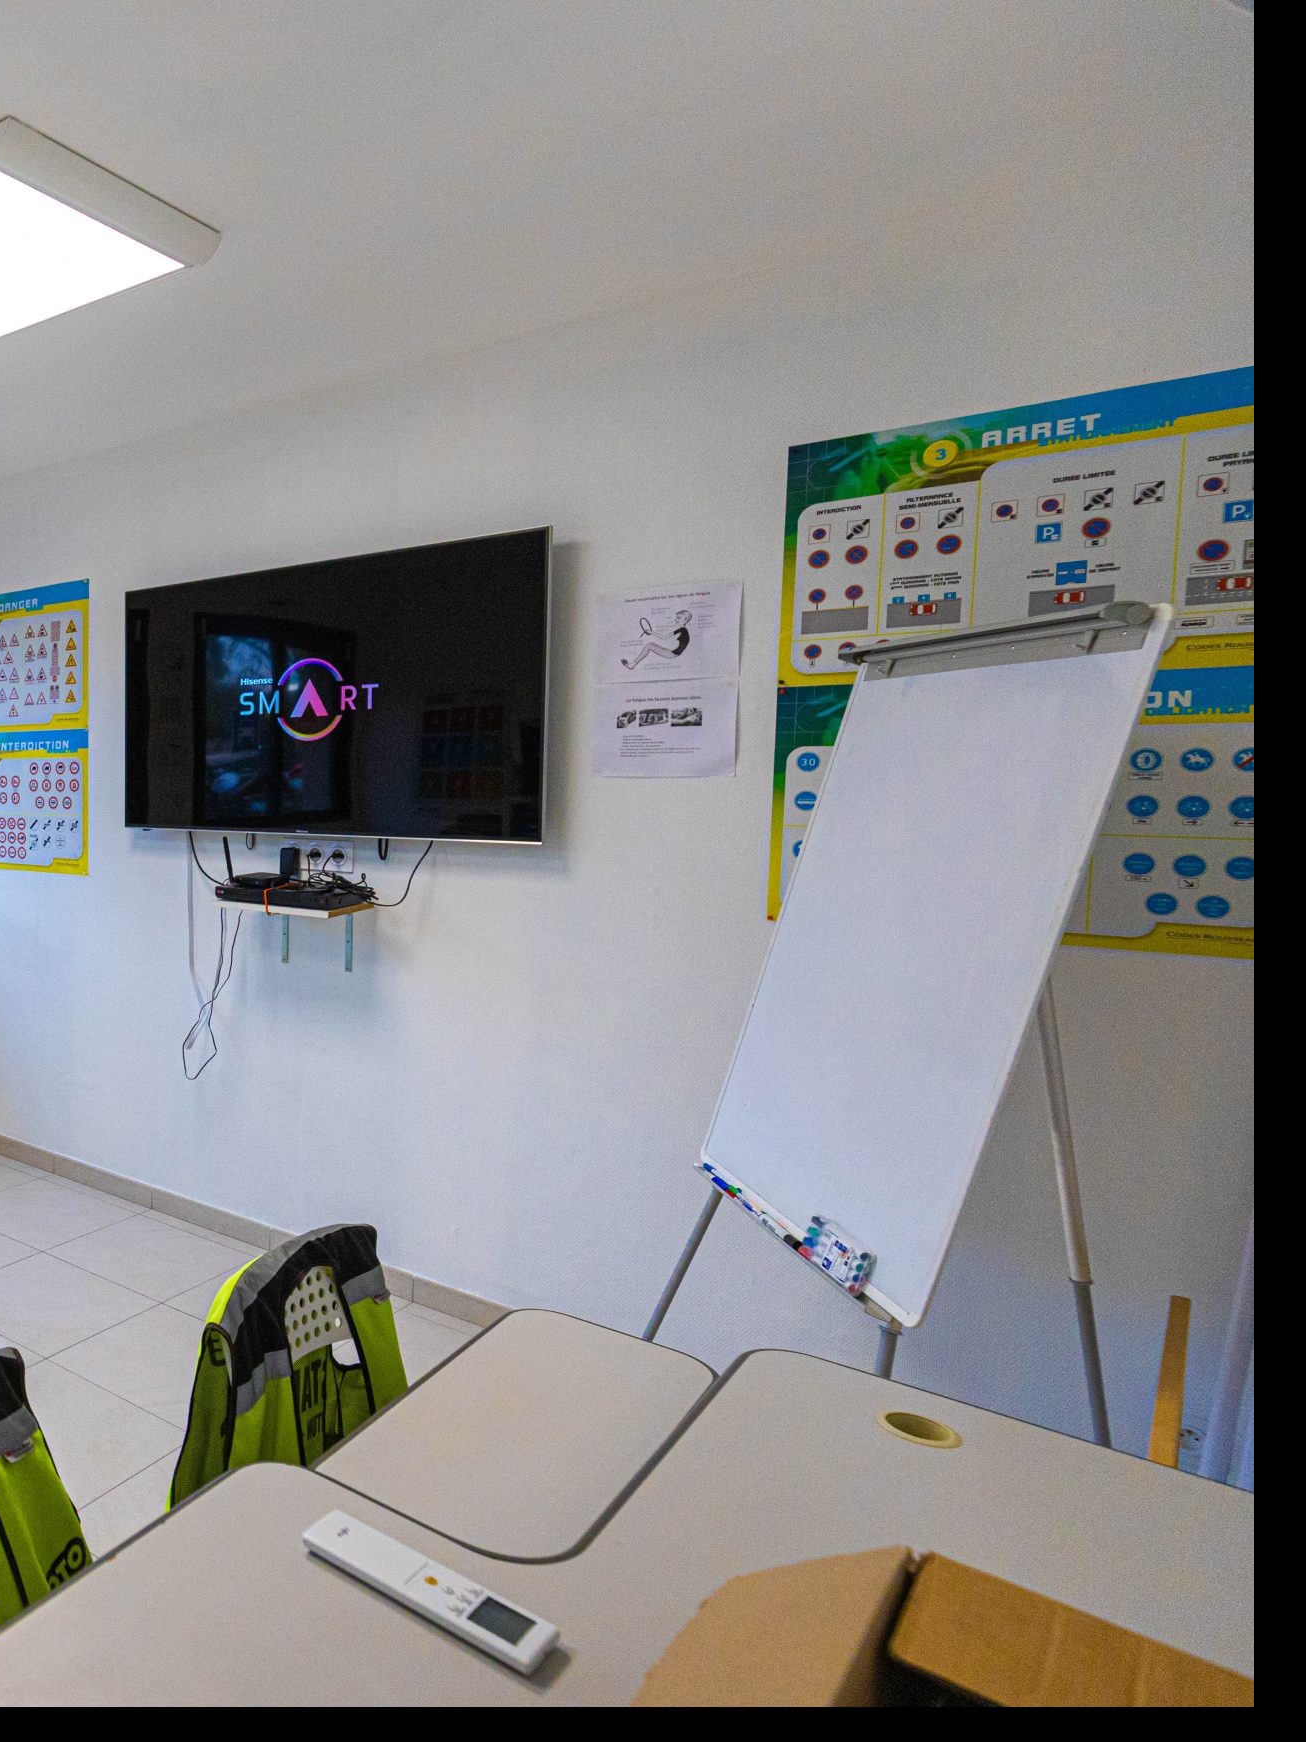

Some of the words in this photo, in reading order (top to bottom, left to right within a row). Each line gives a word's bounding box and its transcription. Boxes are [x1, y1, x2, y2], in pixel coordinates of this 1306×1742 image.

[982, 413, 1102, 448] ARRET
[935, 448, 947, 461] 3
[907, 492, 953, 503] ALTERNANCE
[816, 505, 862, 516] INTERDICTION
[240, 677, 273, 686] Hisense
[240, 678, 379, 718] SMART
[801, 758, 816, 767] 30
